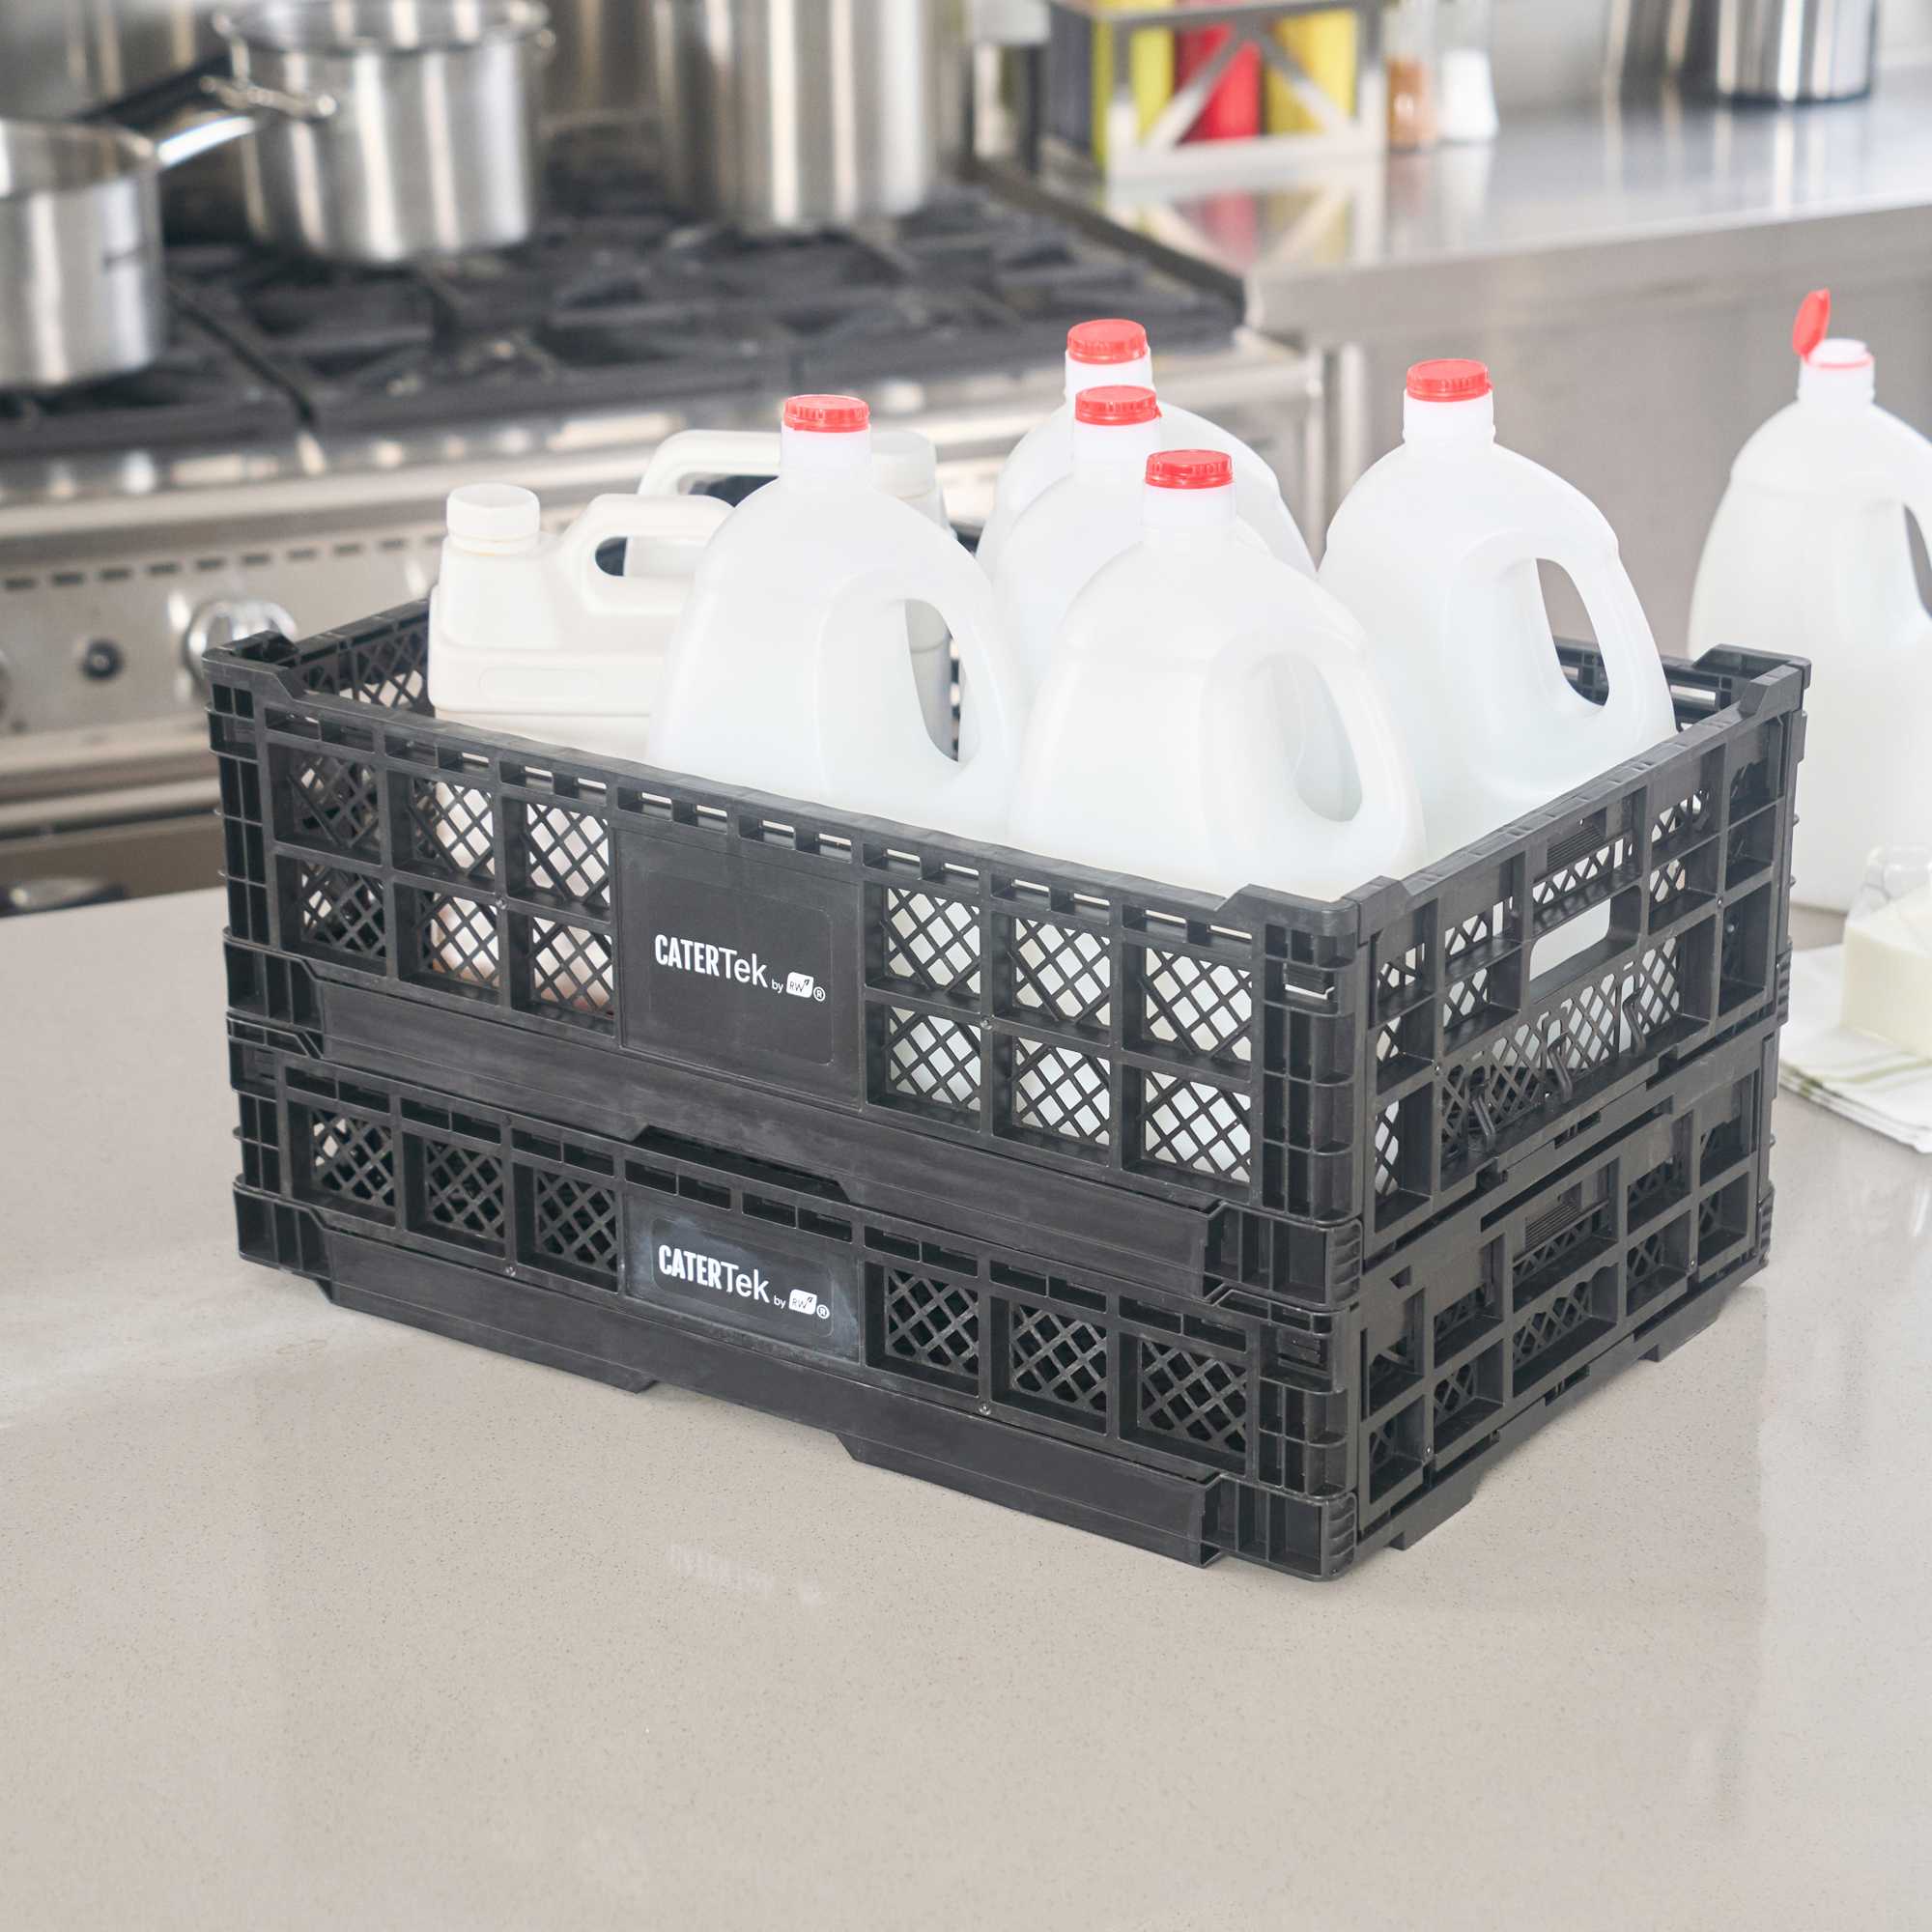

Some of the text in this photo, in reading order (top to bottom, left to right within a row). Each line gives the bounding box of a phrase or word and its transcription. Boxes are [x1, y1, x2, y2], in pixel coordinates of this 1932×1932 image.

[655, 934, 768, 988] CATERTek
[771, 980, 784, 994] by
[658, 1244, 770, 1303] CATERTek
[773, 1294, 786, 1309] by
